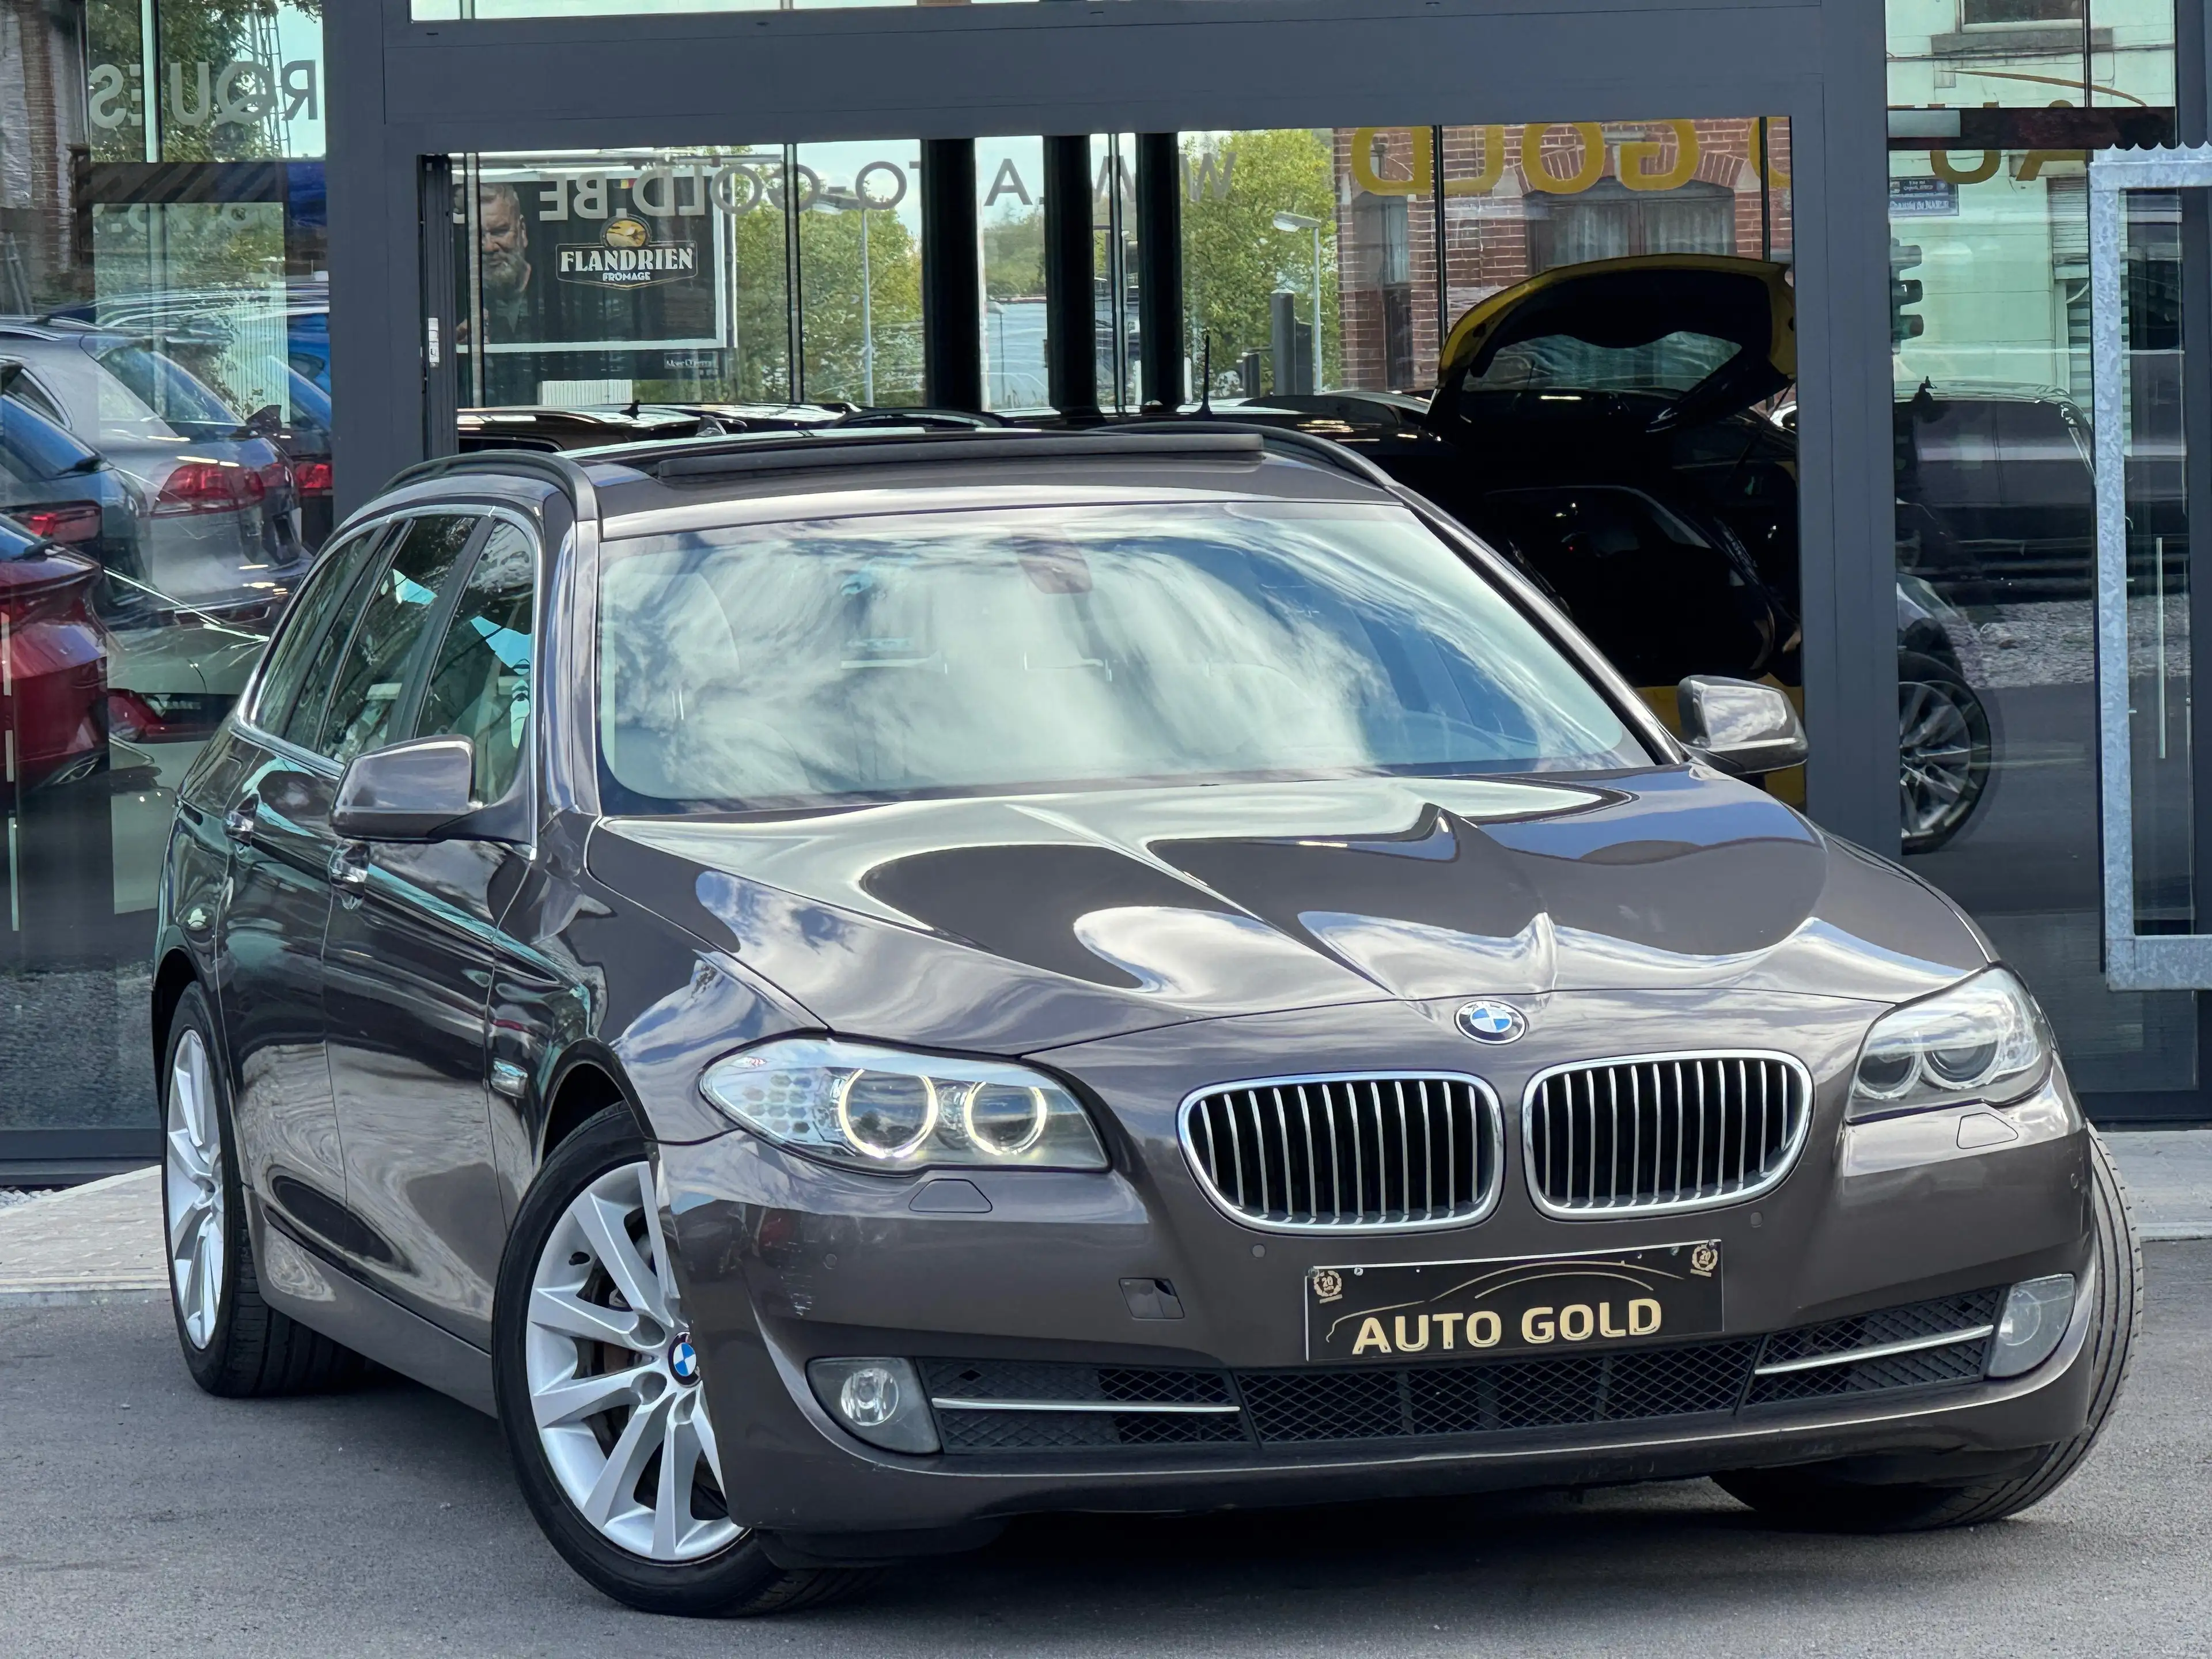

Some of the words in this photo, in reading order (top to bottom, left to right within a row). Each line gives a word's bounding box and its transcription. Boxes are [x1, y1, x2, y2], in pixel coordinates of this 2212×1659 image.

[560, 248, 693, 272] FLANDRIEN
[603, 272, 651, 282] FROMAGE
[1352, 1311, 1502, 1354] AUTO
[1521, 1298, 1661, 1344] GOLD
